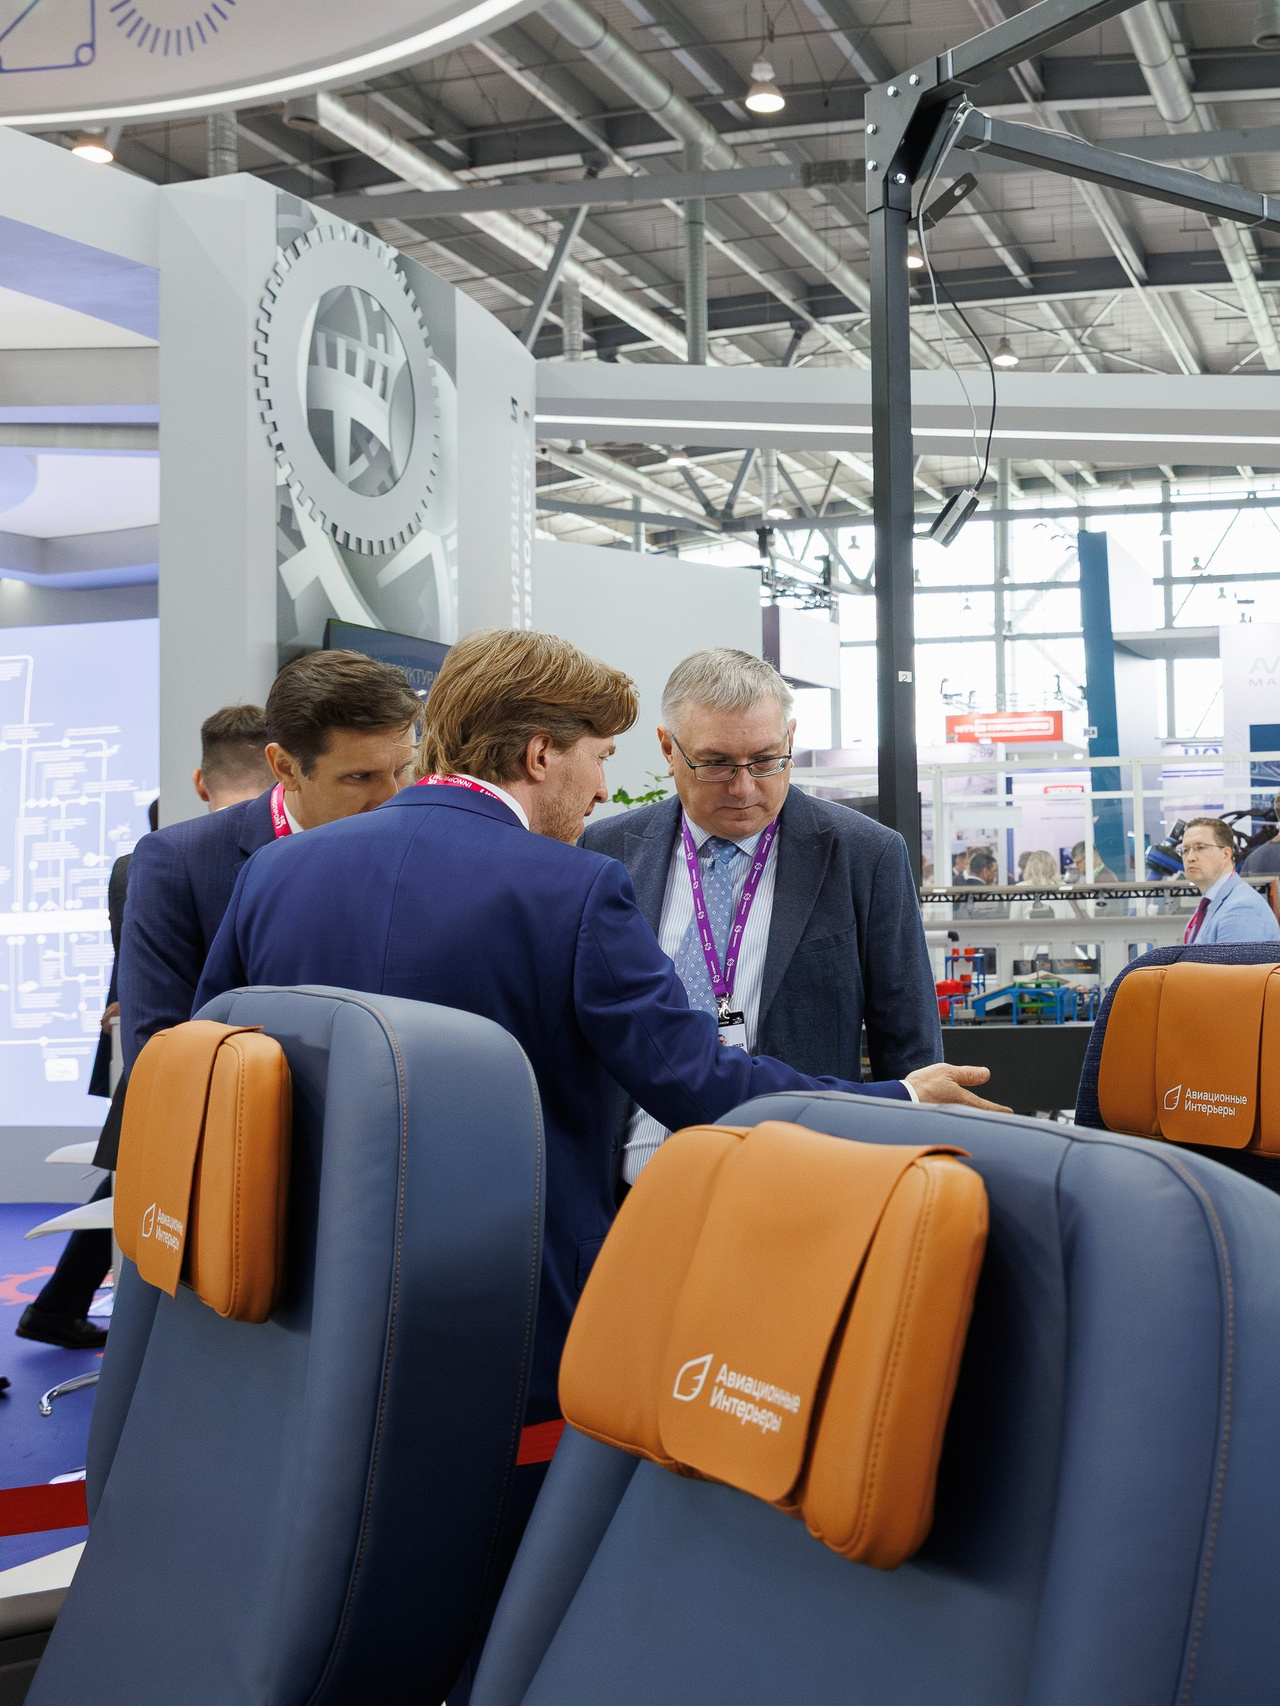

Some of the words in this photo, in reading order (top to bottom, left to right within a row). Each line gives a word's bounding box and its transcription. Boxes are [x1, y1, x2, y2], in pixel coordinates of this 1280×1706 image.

[432, 773, 472, 789] INNOPM
[1184, 1088, 1248, 1105] Авиационные
[1184, 1100, 1236, 1118] Интерьеры
[715, 1363, 801, 1414] Авиационные
[709, 1385, 783, 1435] Интерьеры
